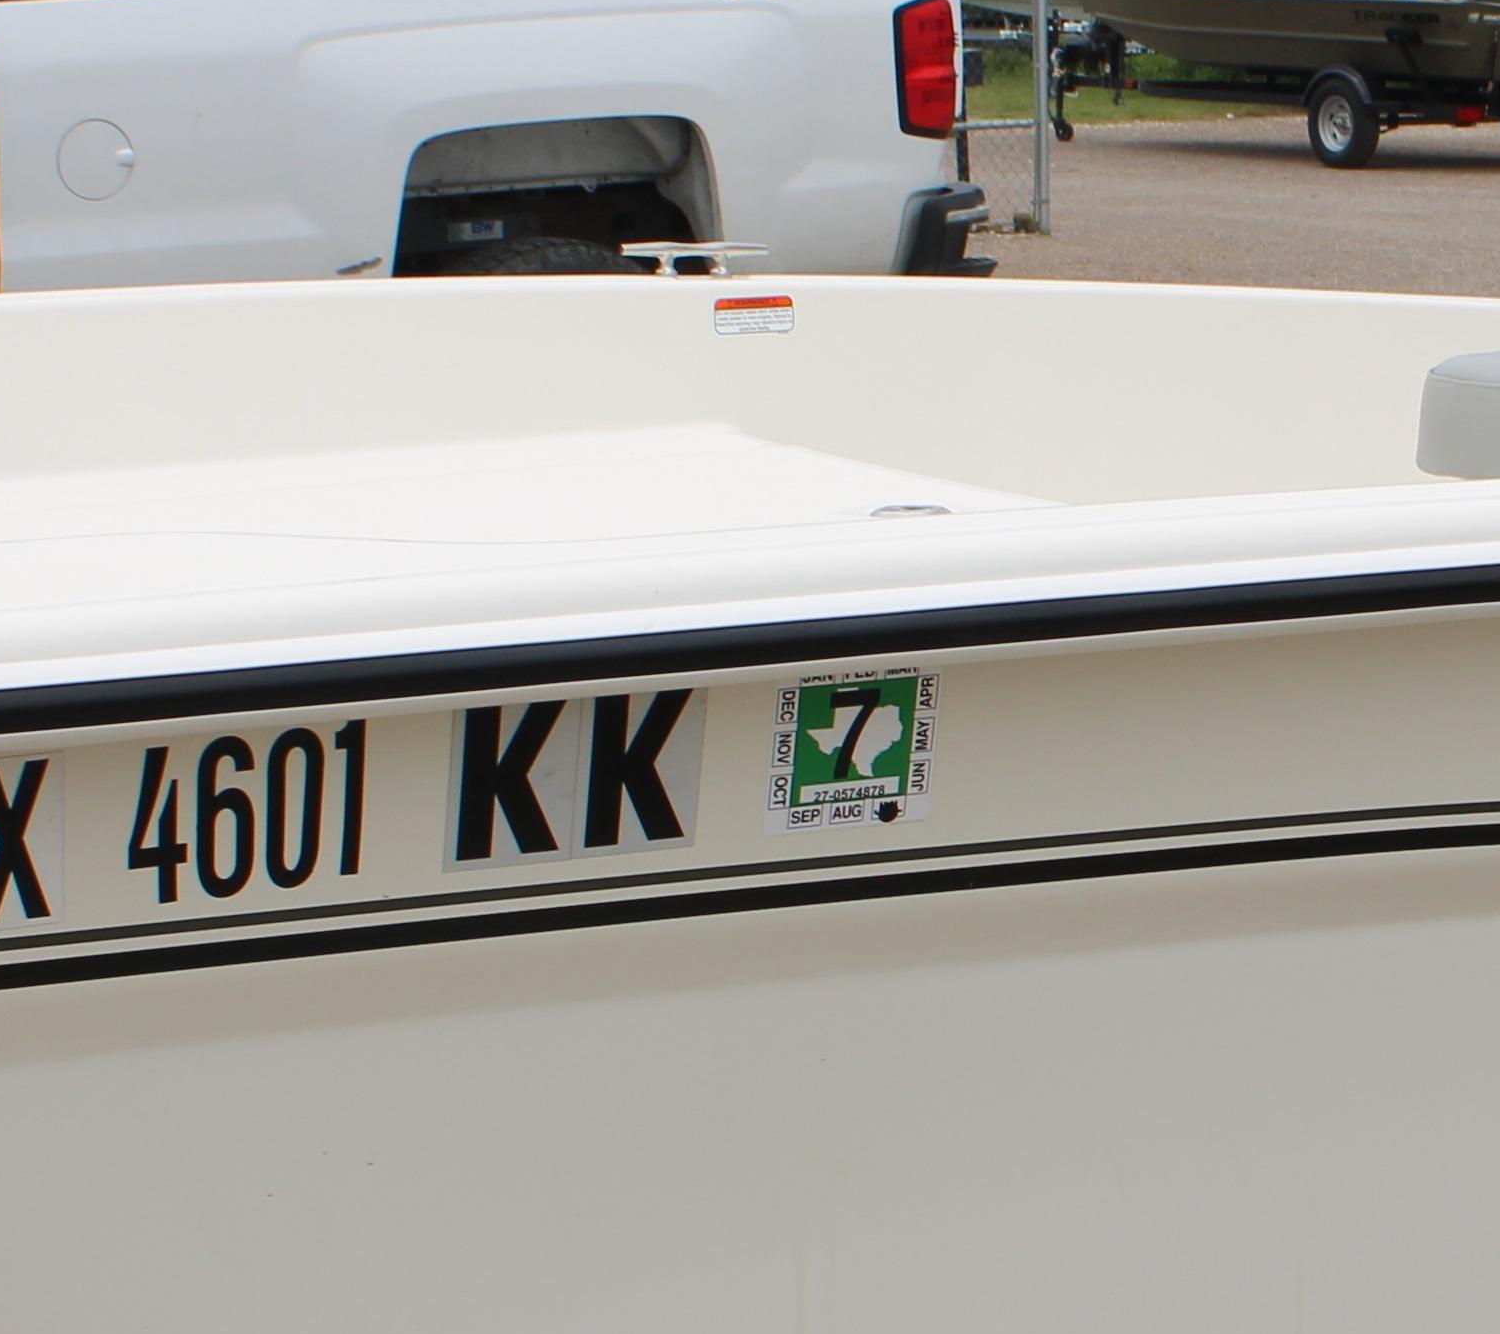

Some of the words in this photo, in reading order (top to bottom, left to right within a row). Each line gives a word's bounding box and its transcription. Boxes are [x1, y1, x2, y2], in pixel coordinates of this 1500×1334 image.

[780, 690, 796, 722] DEC
[919, 676, 935, 708] APR
[776, 733, 792, 765] NOV
[830, 687, 882, 780] 7
[914, 720, 930, 752] MAY
[773, 776, 788, 807] OCT
[911, 762, 925, 792] JUN
[127, 718, 367, 904] 4601
[455, 688, 695, 863] KK
[813, 784, 886, 803] 27-0574878
[790, 808, 821, 825] SEP
[831, 803, 862, 820] AUG
